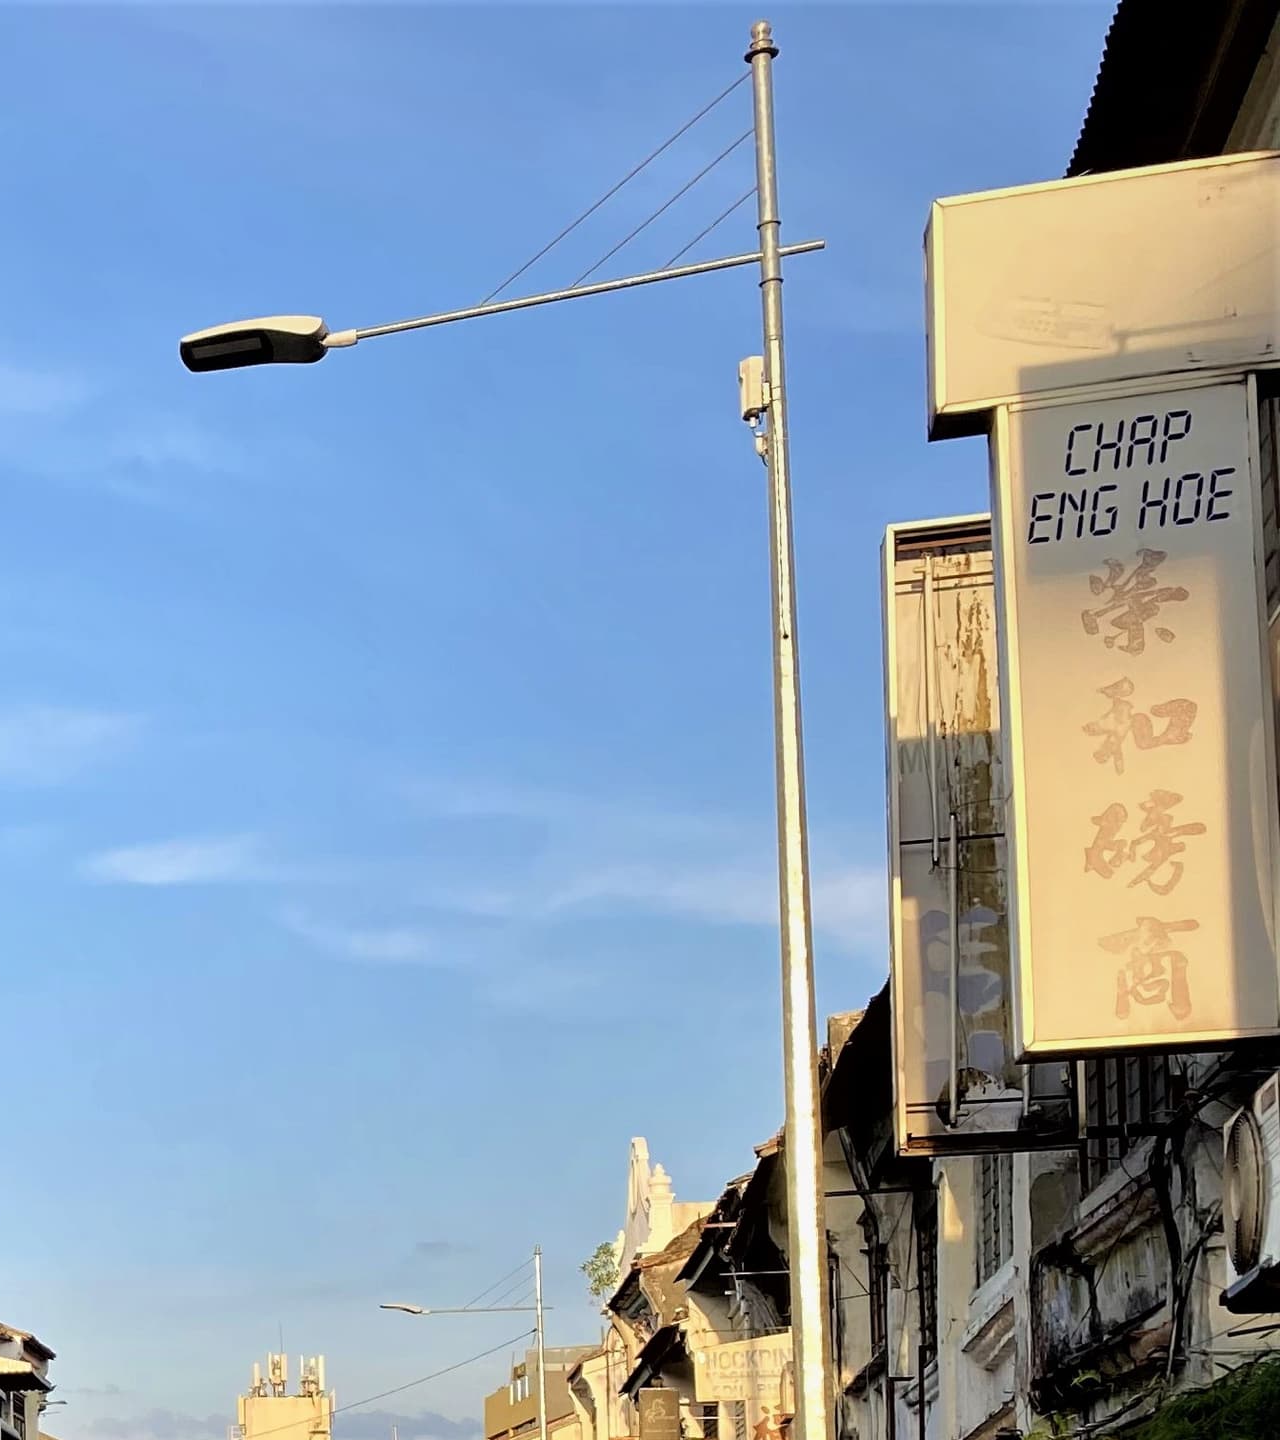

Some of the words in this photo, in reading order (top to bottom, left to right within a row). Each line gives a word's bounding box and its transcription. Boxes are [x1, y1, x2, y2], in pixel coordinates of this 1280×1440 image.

[1065, 409, 1192, 477] CHAP
[1027, 484, 1118, 544] ENG
[1138, 467, 1236, 530] HOE
